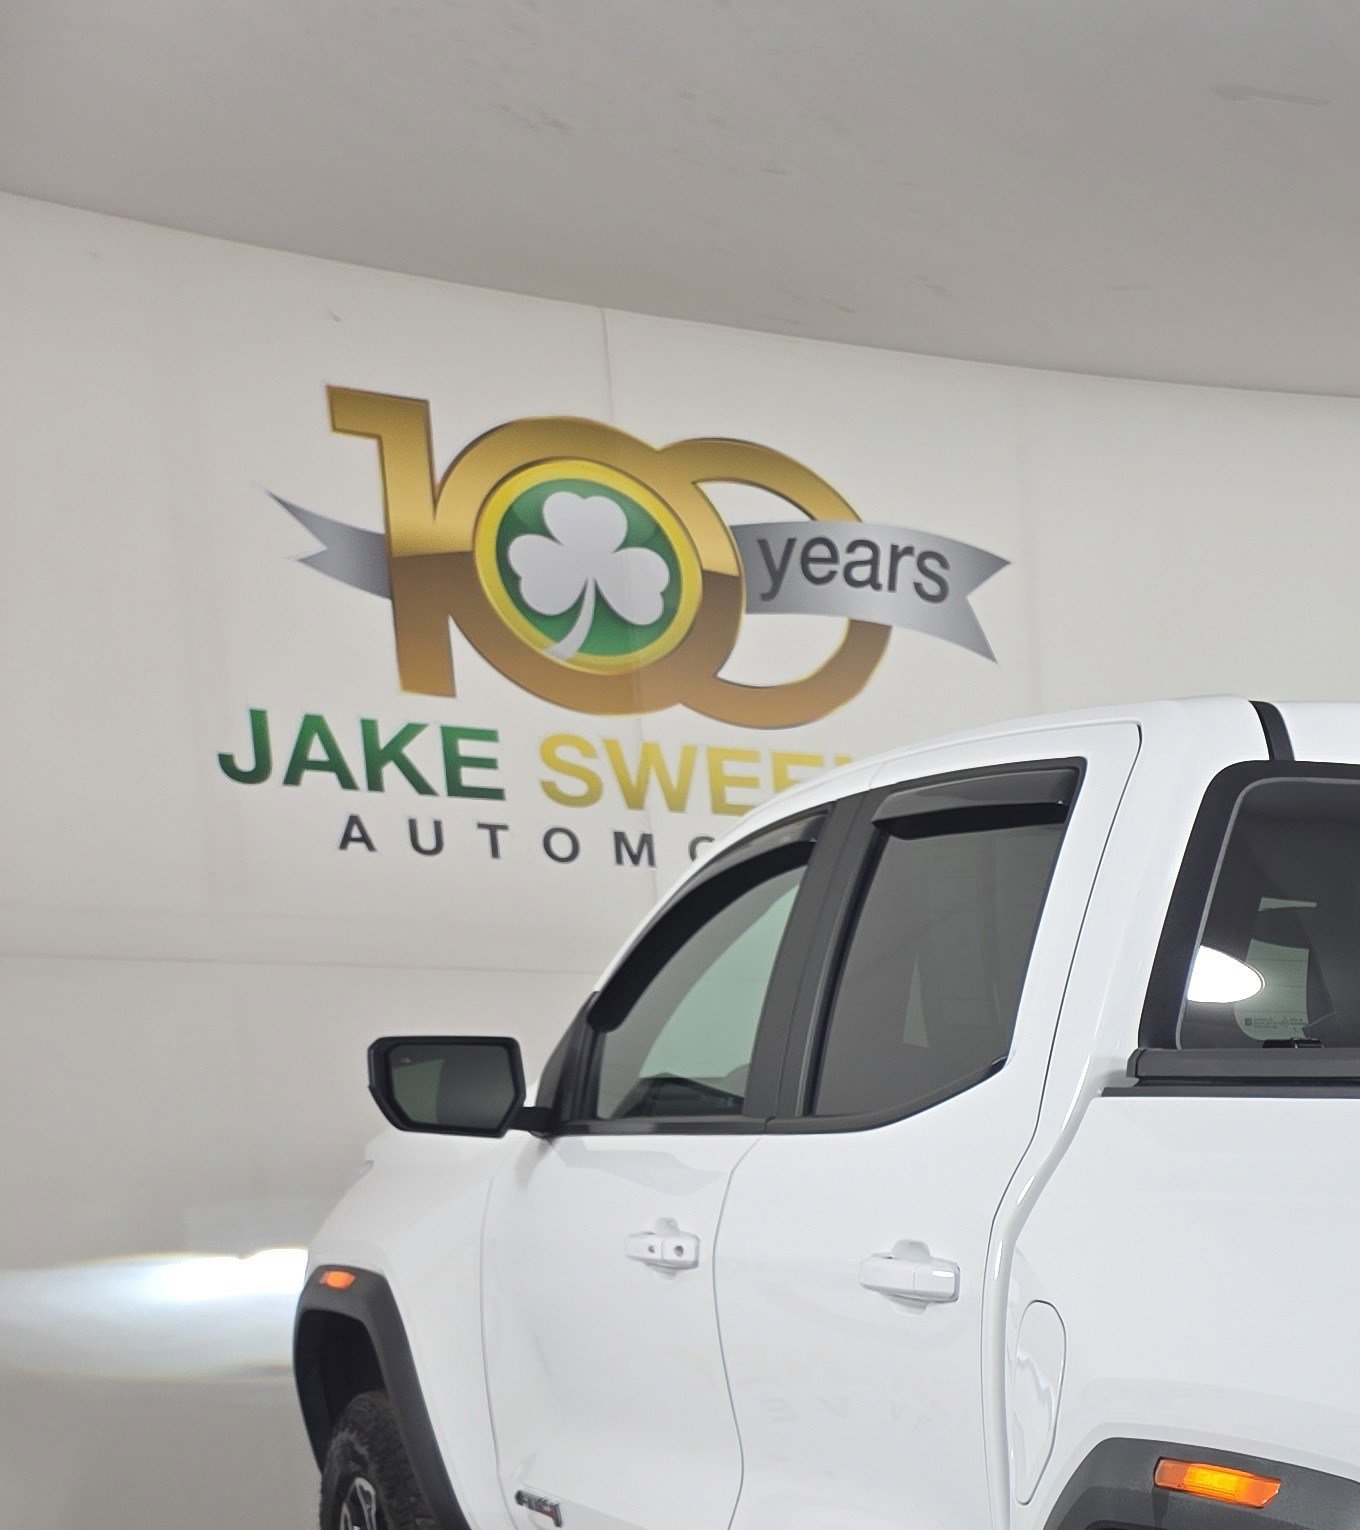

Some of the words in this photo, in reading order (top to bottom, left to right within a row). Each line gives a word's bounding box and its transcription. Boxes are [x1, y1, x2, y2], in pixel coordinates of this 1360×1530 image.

[325, 384, 894, 730] 100
[755, 533, 953, 605] years
[217, 708, 507, 801] JAKE
[538, 732, 852, 817] SWEE
